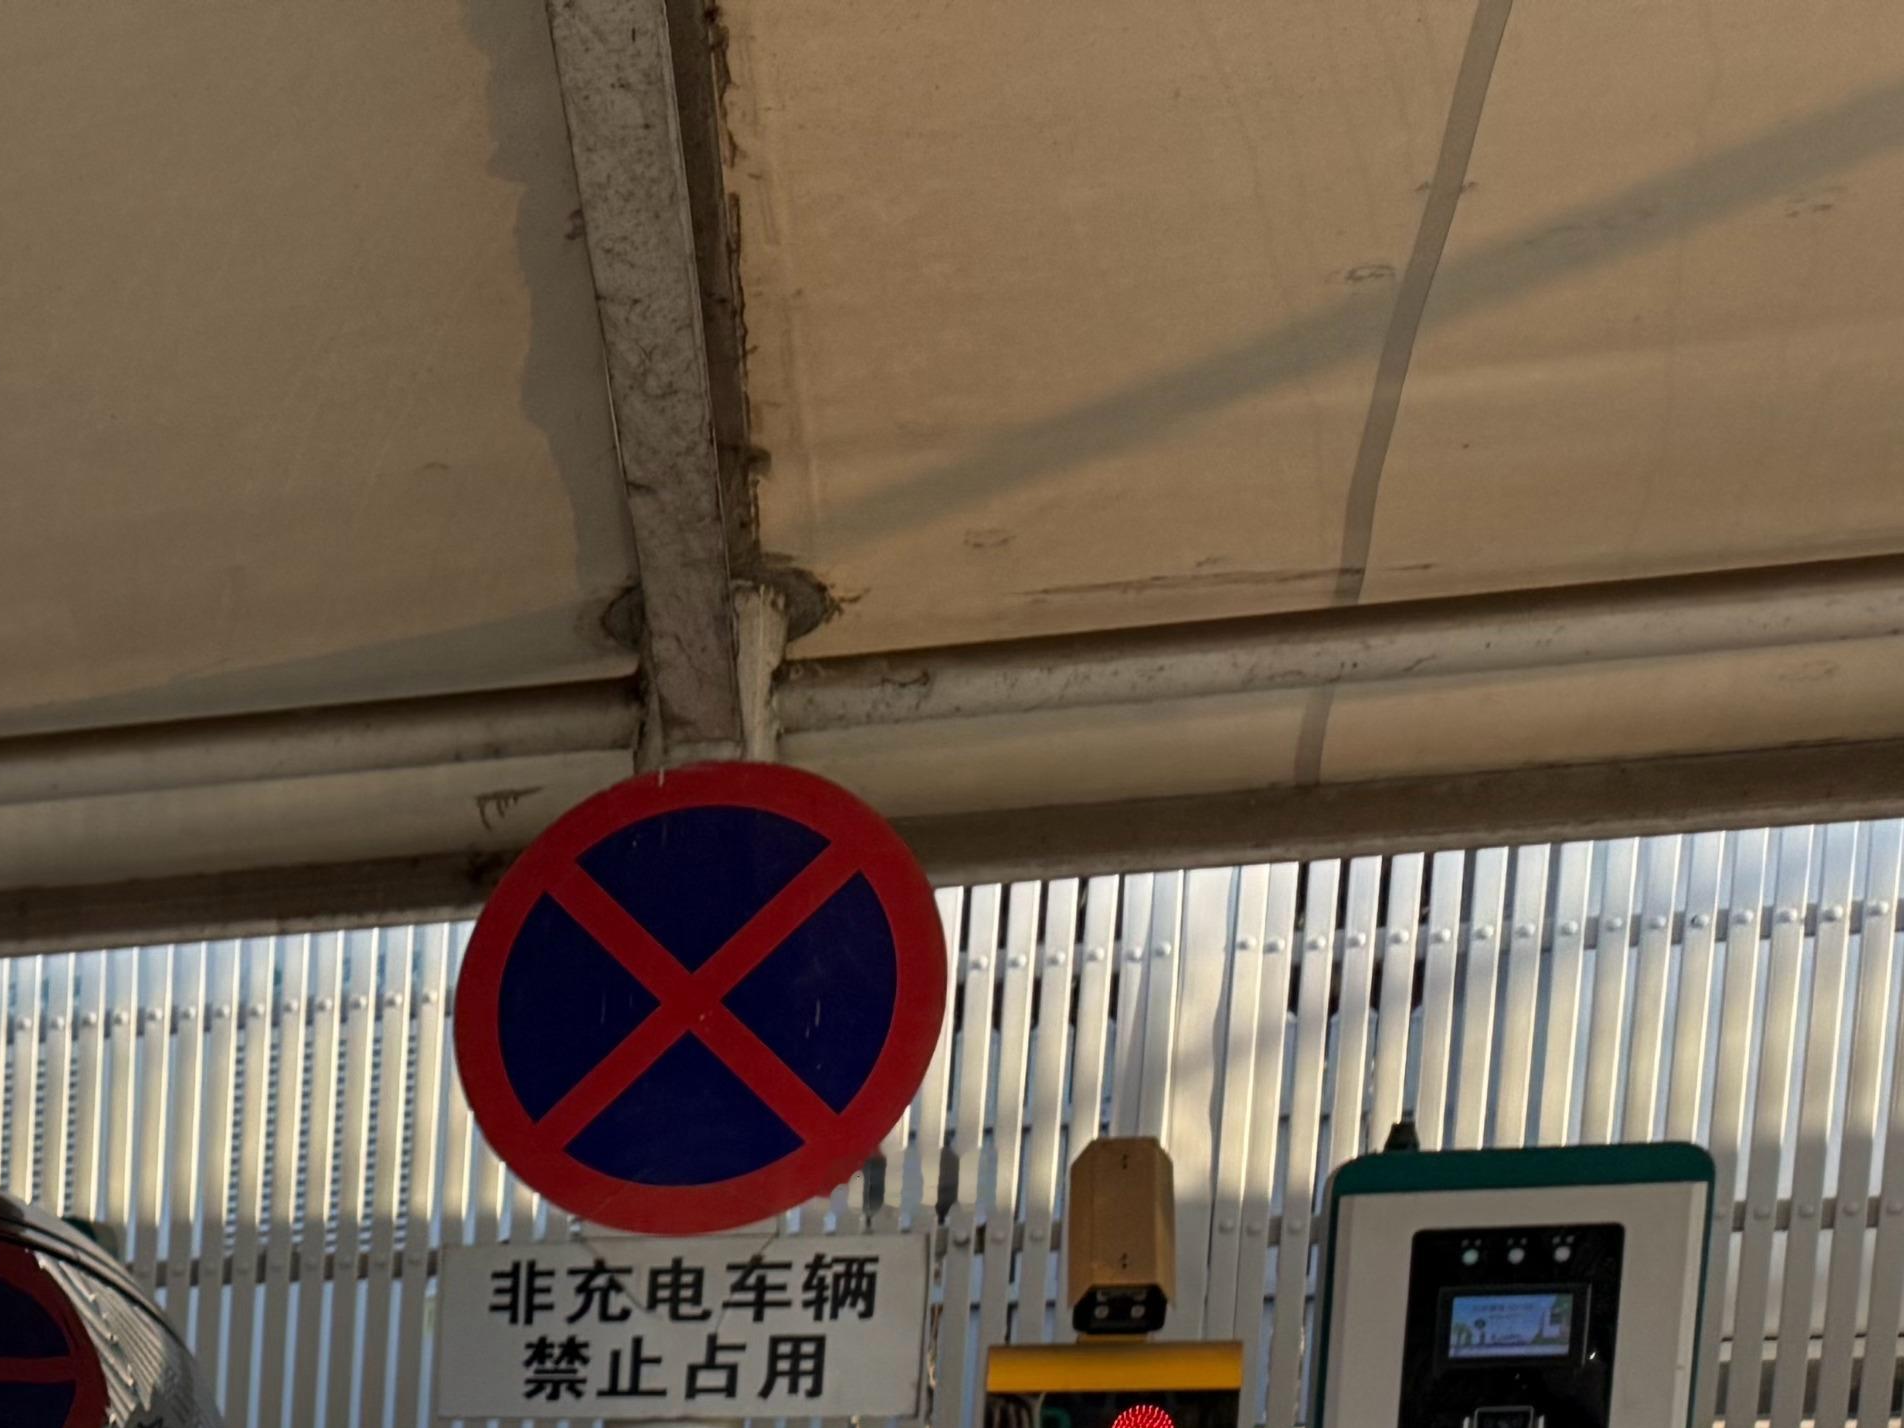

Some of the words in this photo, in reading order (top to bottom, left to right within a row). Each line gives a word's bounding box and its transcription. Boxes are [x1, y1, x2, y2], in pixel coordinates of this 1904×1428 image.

[489, 1253, 880, 1325] 非充电车辆
[522, 1335, 827, 1401] 禁止占用
